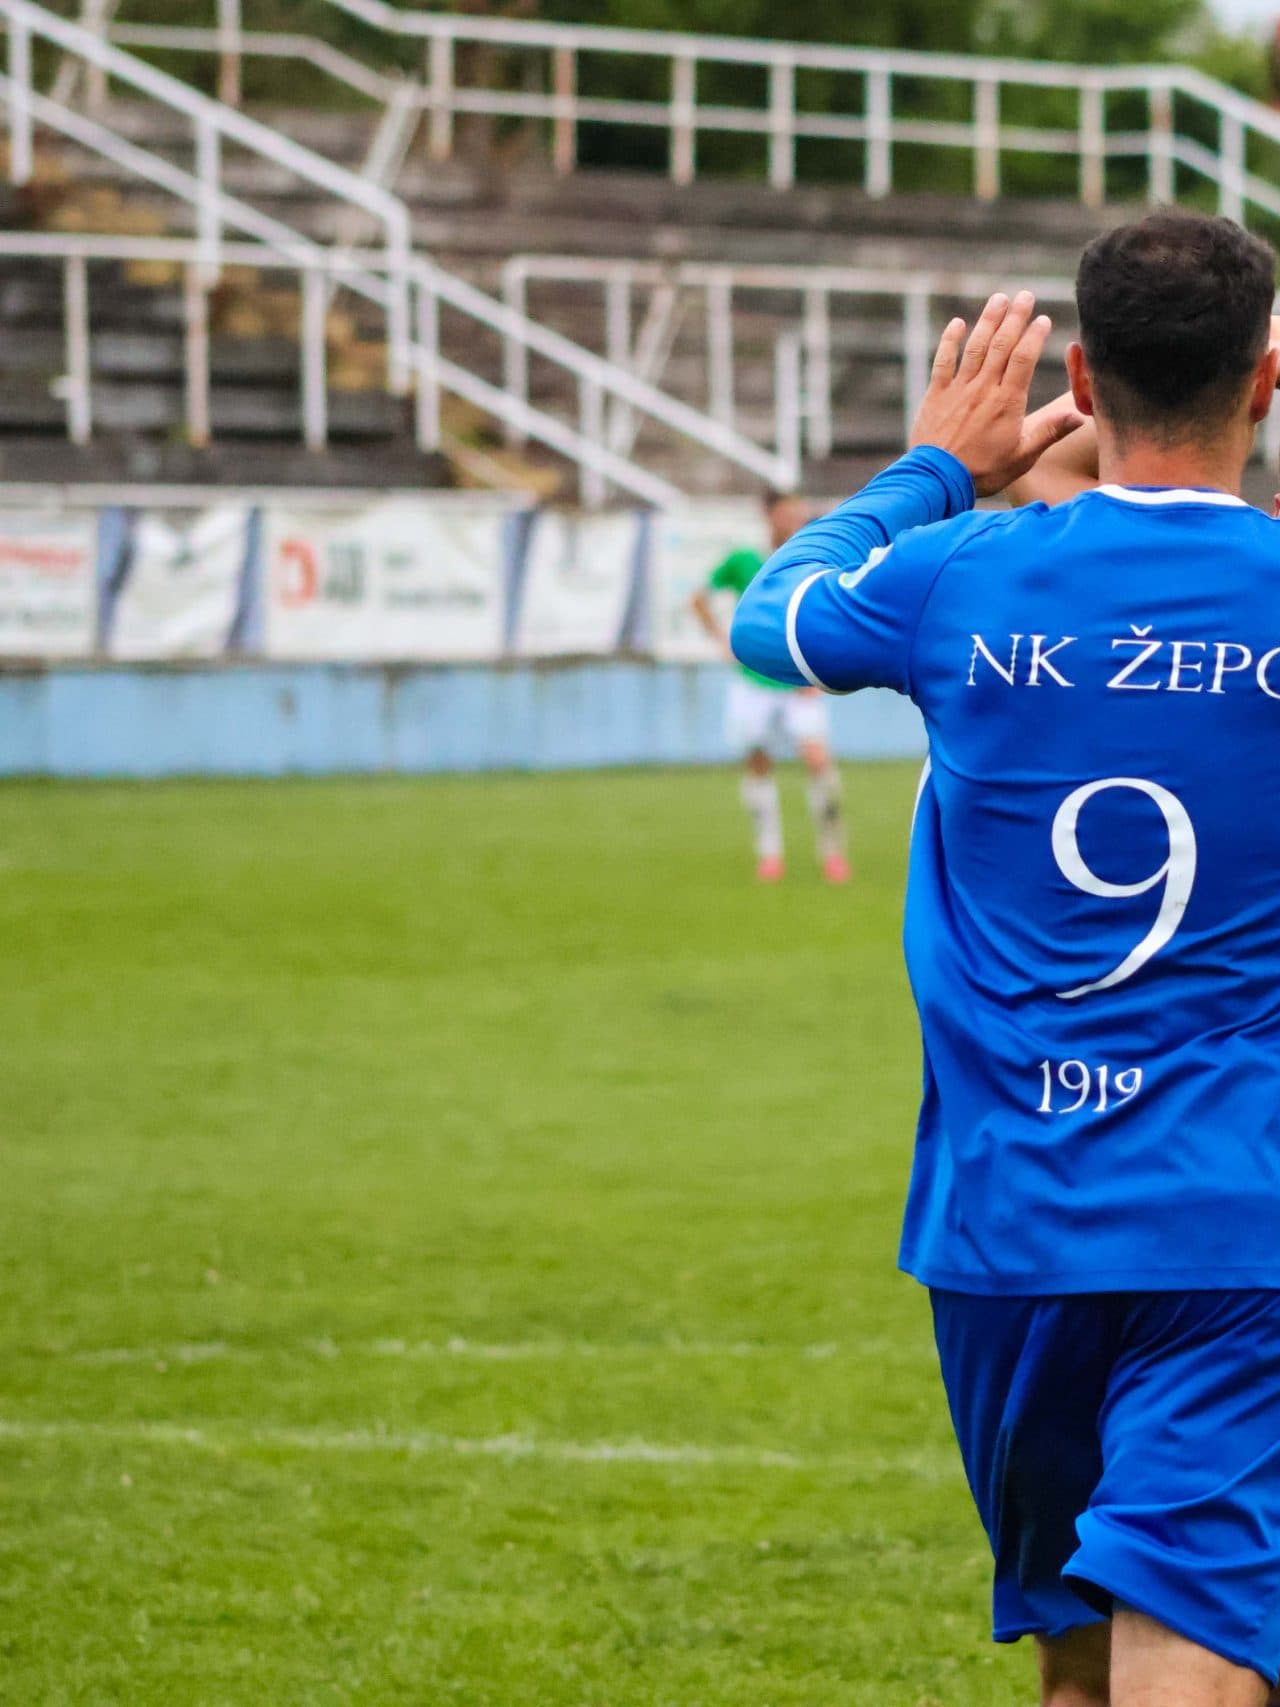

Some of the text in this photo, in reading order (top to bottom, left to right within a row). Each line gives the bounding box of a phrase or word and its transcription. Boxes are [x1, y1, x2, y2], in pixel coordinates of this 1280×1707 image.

[966, 632, 1078, 688] NK
[1051, 776, 1198, 1000] 9
[1036, 1058, 1144, 1114] 1919
